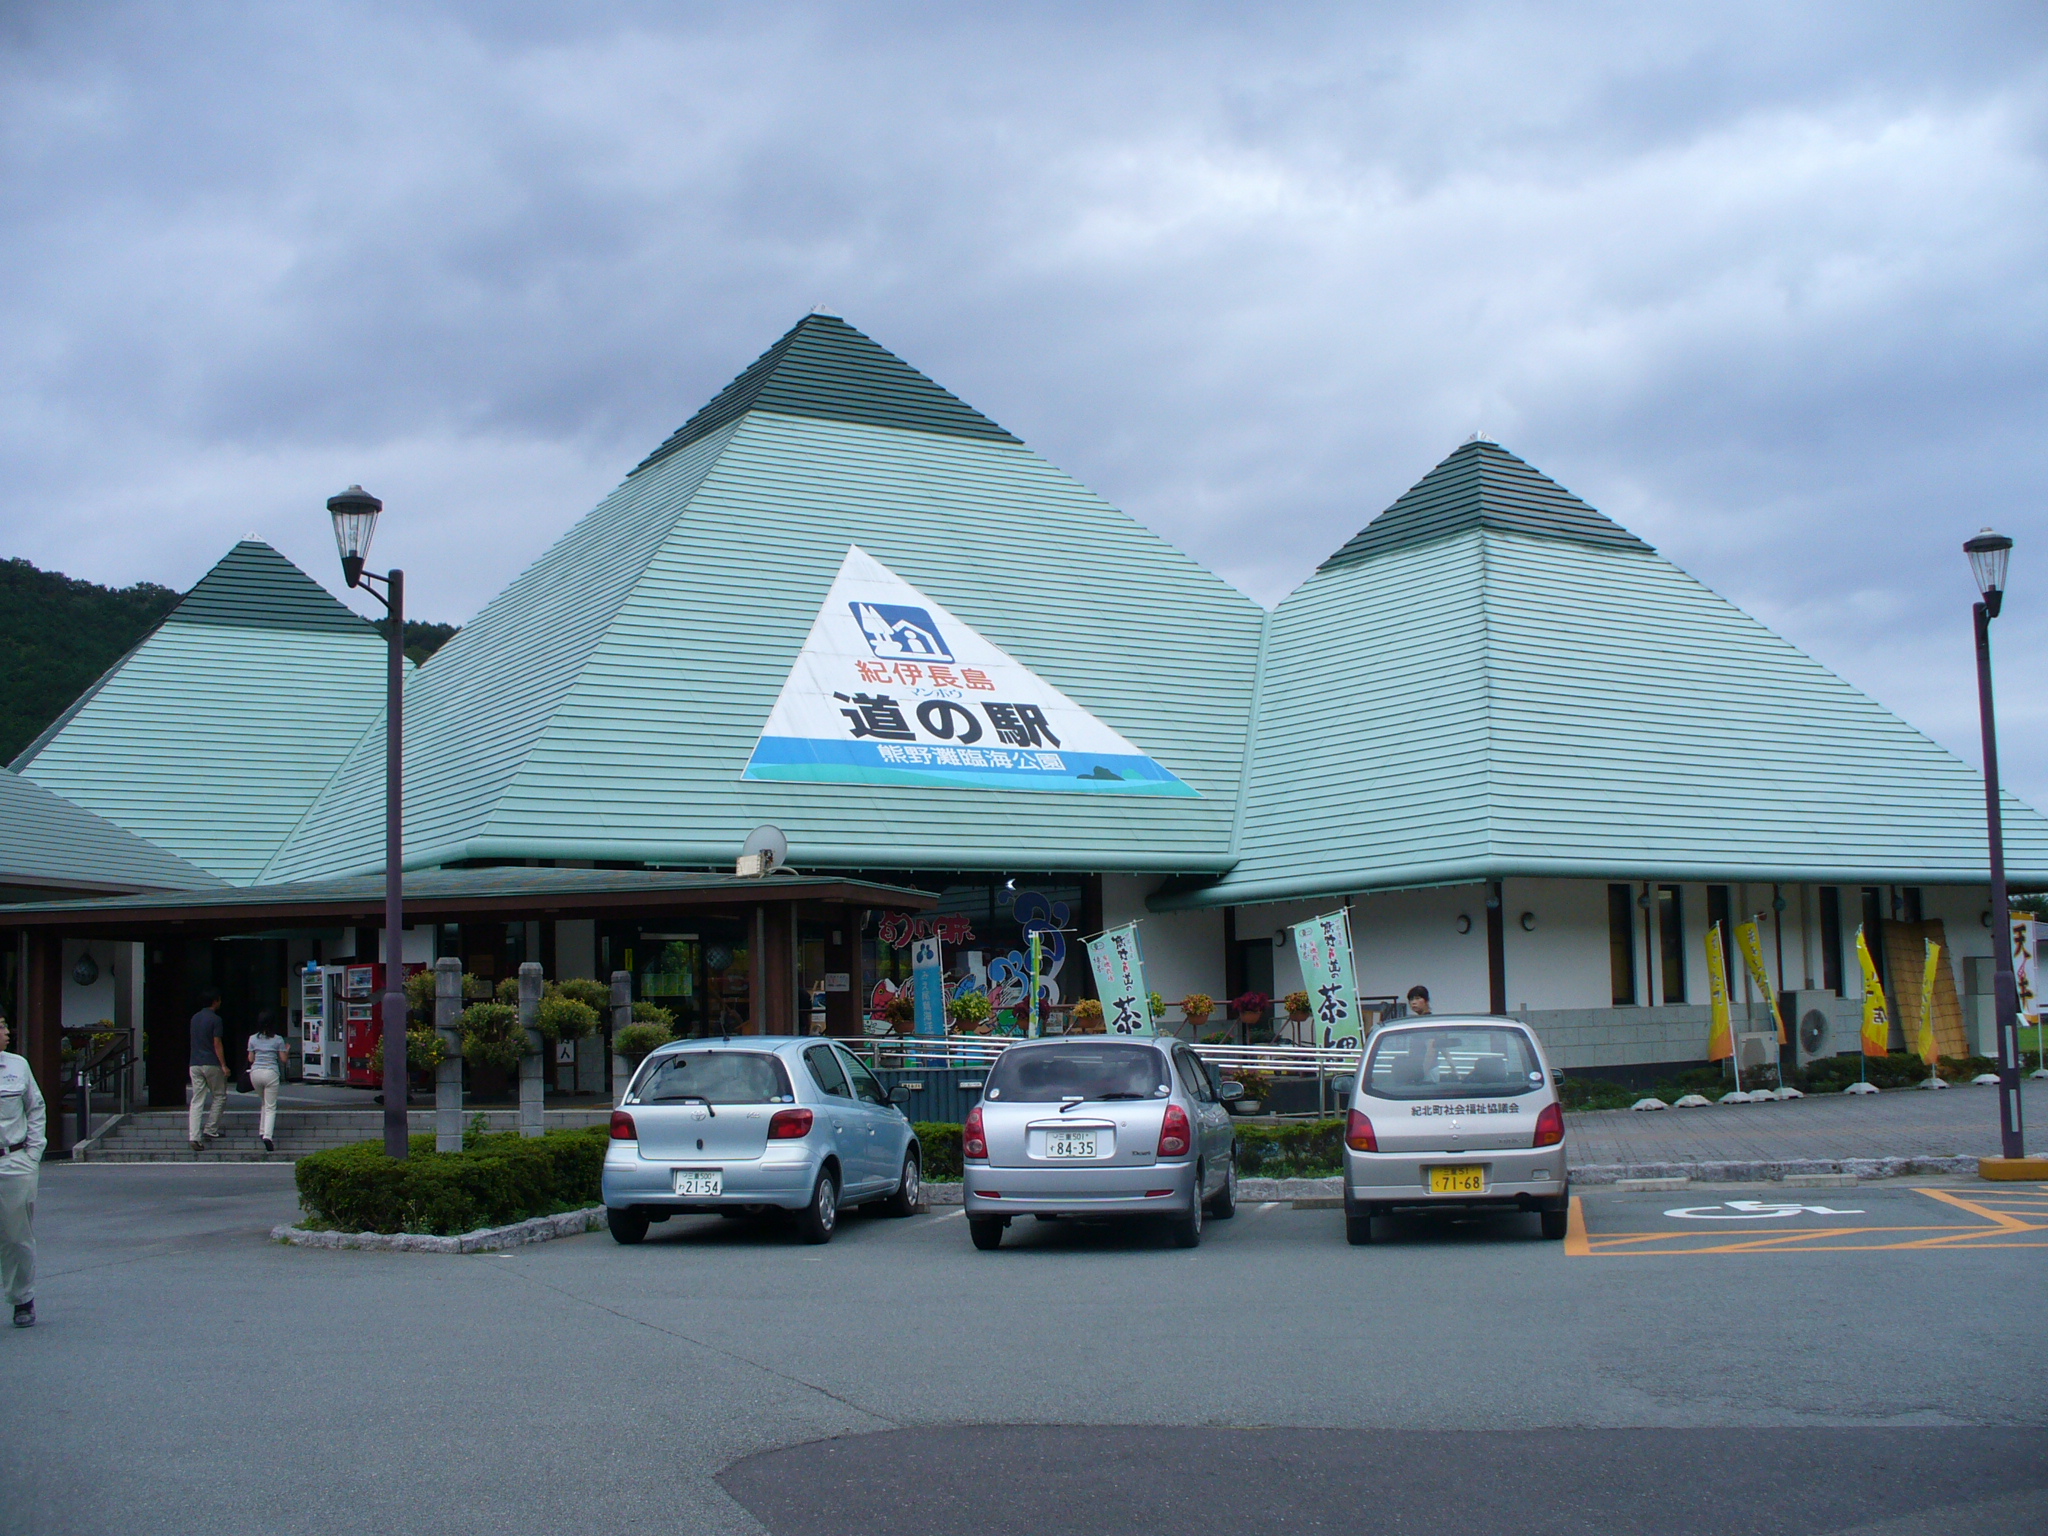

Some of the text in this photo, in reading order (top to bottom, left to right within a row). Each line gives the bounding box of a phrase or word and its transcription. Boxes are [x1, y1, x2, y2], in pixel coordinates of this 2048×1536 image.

[855, 659, 996, 692] 紀伊長島
[832, 691, 1062, 749] 道の駅
[876, 743, 1067, 772] 熊野灘臨海公園
[1411, 1102, 1519, 1116] 紀北町社会福祉協議会
[1057, 1141, 1093, 1155] 84-35
[686, 1180, 718, 1193] 21-54
[1442, 1176, 1480, 1190] 71-68
